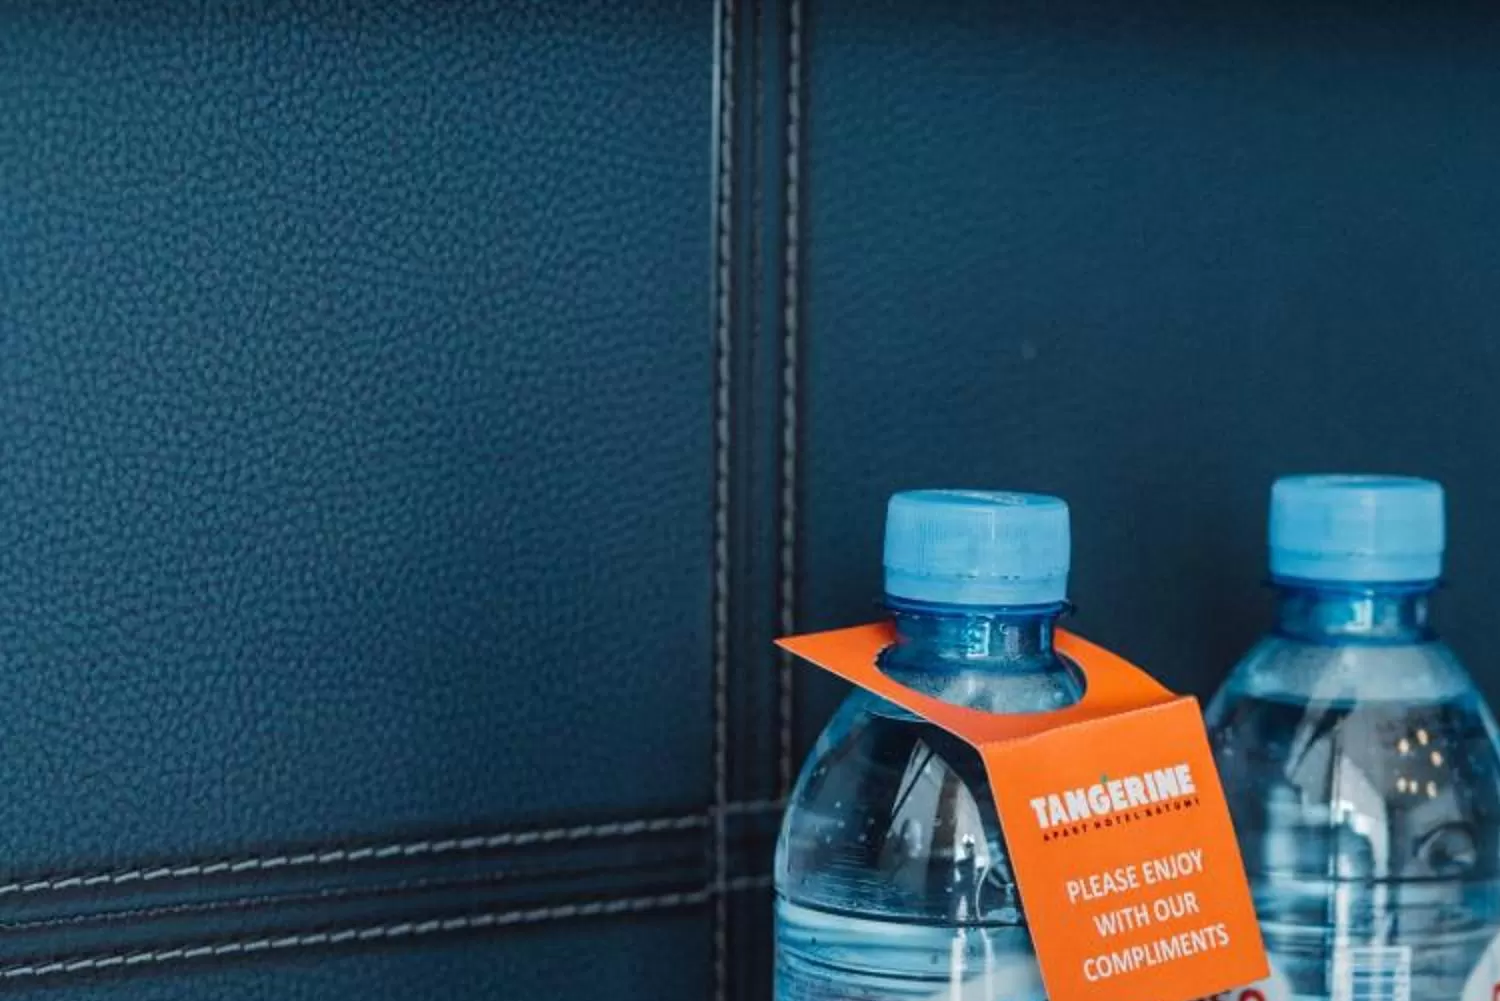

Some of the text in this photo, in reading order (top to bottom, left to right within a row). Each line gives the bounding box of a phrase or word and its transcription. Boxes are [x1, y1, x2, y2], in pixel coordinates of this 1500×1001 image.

[1029, 763, 1196, 829] TANGERINE
[1066, 848, 1204, 904] PLEASE ENJOY
[1092, 891, 1200, 937] WITH OUR
[1083, 923, 1230, 982] COMPLIMENTS
